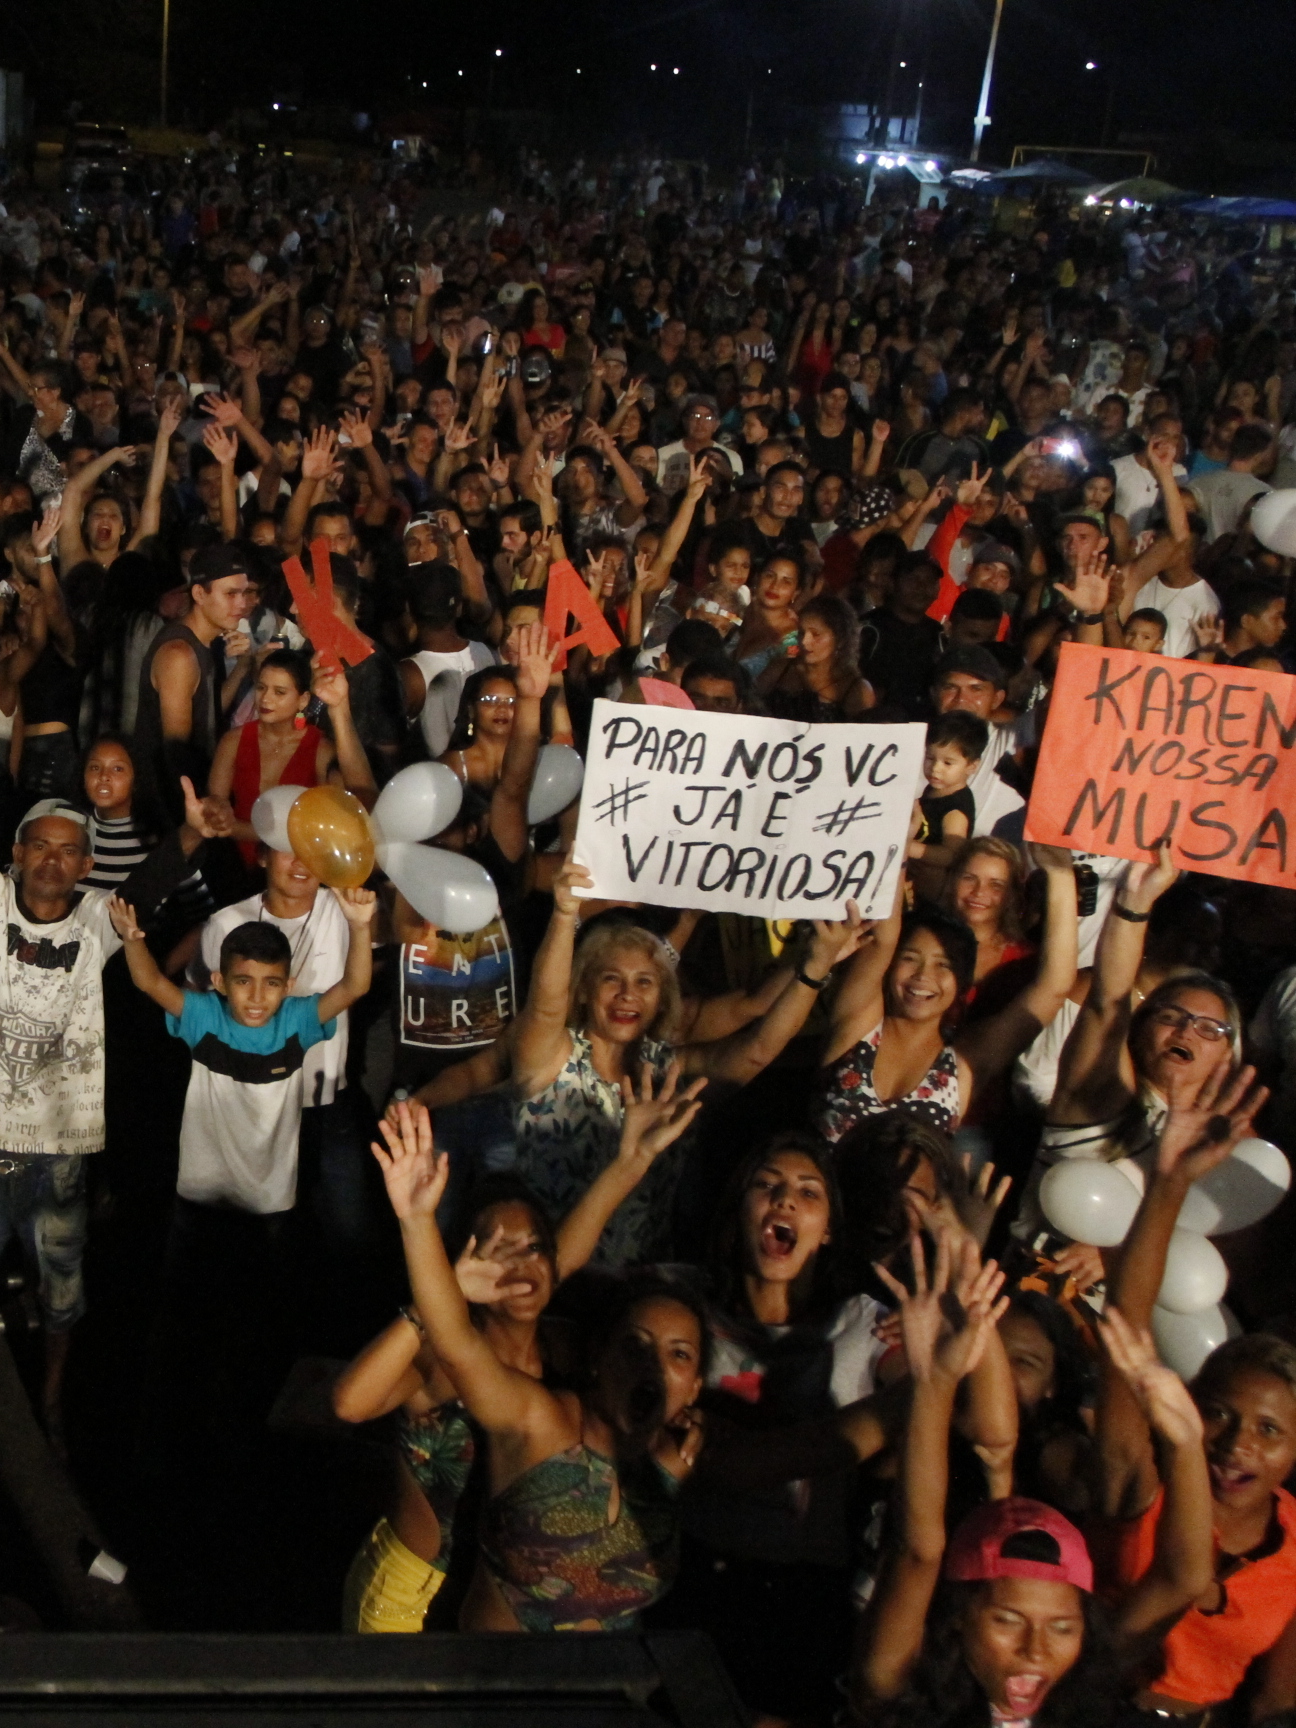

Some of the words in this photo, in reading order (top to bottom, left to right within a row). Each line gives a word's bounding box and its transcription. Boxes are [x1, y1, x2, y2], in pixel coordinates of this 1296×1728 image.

[280, 537, 377, 675] K
[540, 558, 621, 673] A
[1084, 657, 1296, 751] KAREN
[602, 716, 707, 776] PARA
[721, 733, 826, 785] NÓS
[844, 743, 899, 788] VC
[1110, 737, 1279, 791] NOSSA
[673, 783, 757, 832] JÁ
[622, 833, 899, 914] VITORIOSA!
